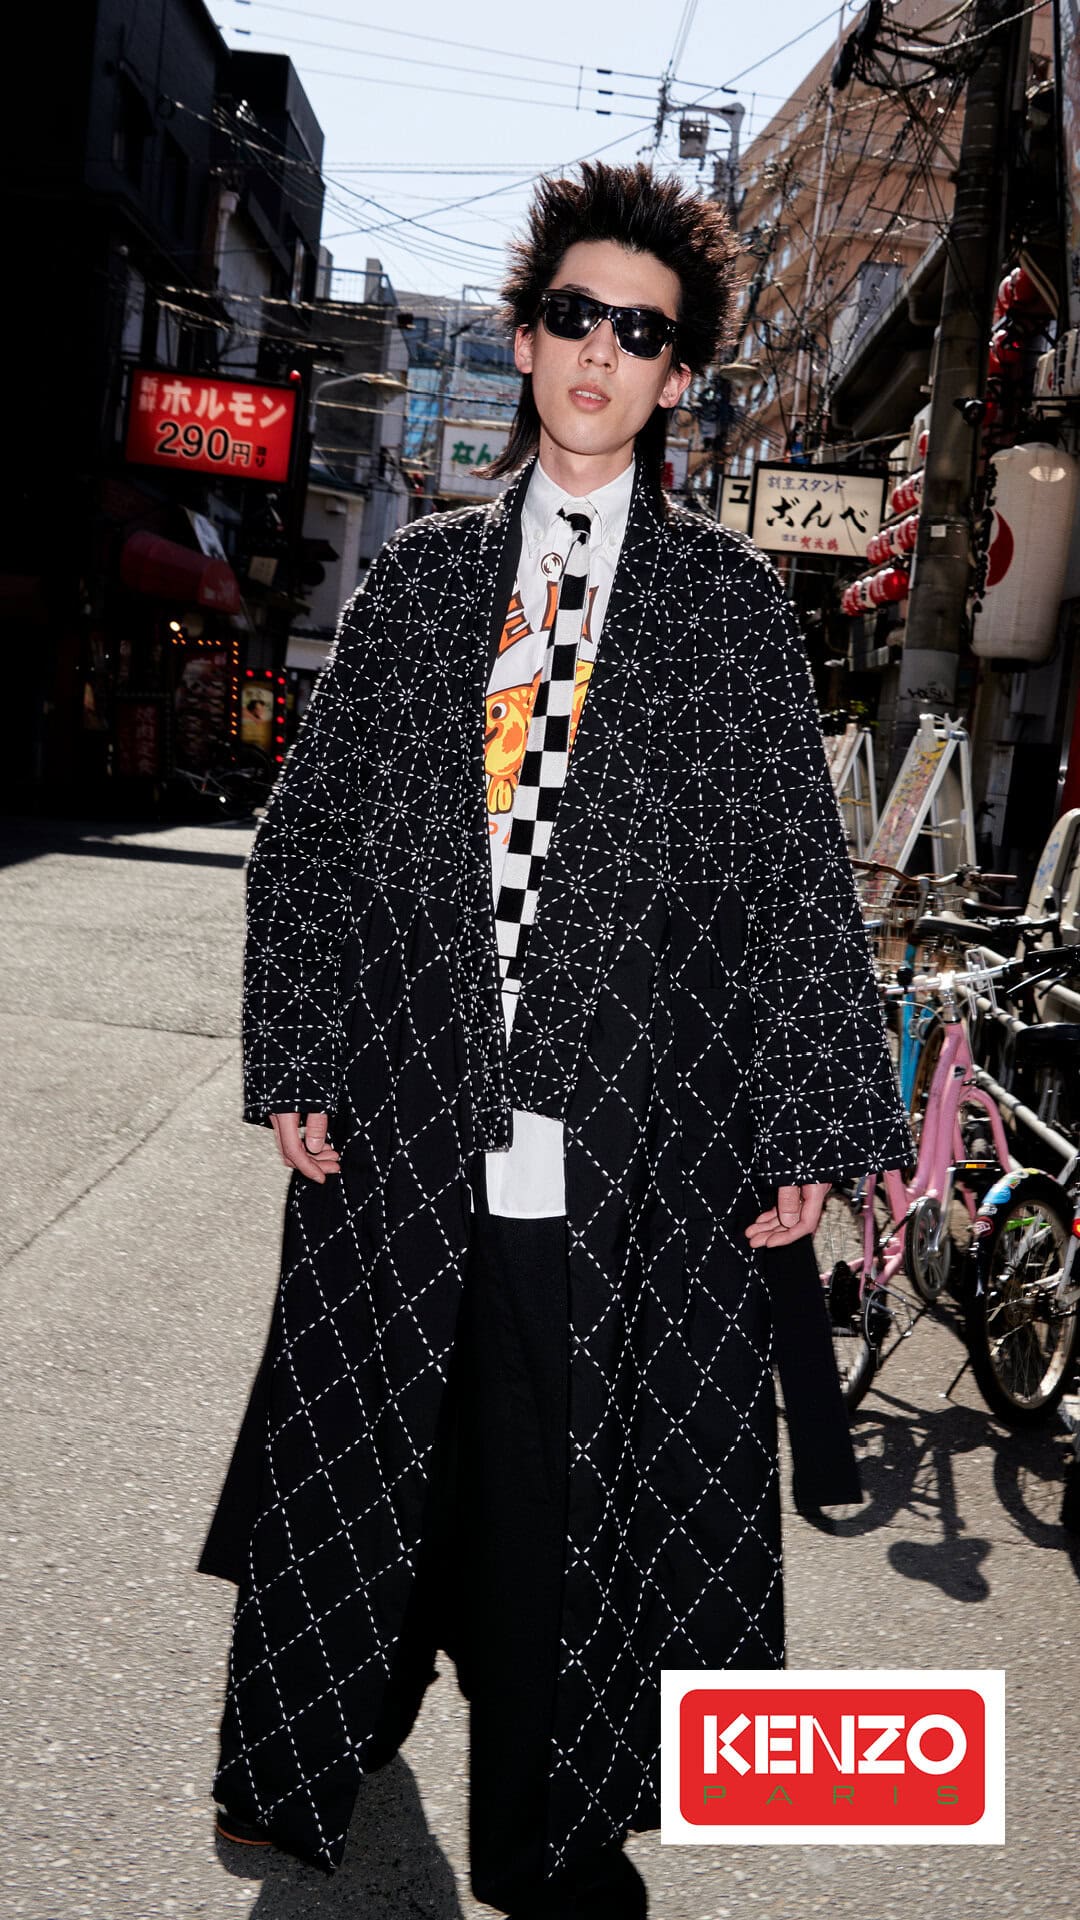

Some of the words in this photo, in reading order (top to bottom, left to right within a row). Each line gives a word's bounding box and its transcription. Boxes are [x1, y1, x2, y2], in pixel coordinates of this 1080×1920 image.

[160, 380, 287, 428] ホルモン
[155, 420, 252, 467] 290円
[451, 440, 501, 465] なん
